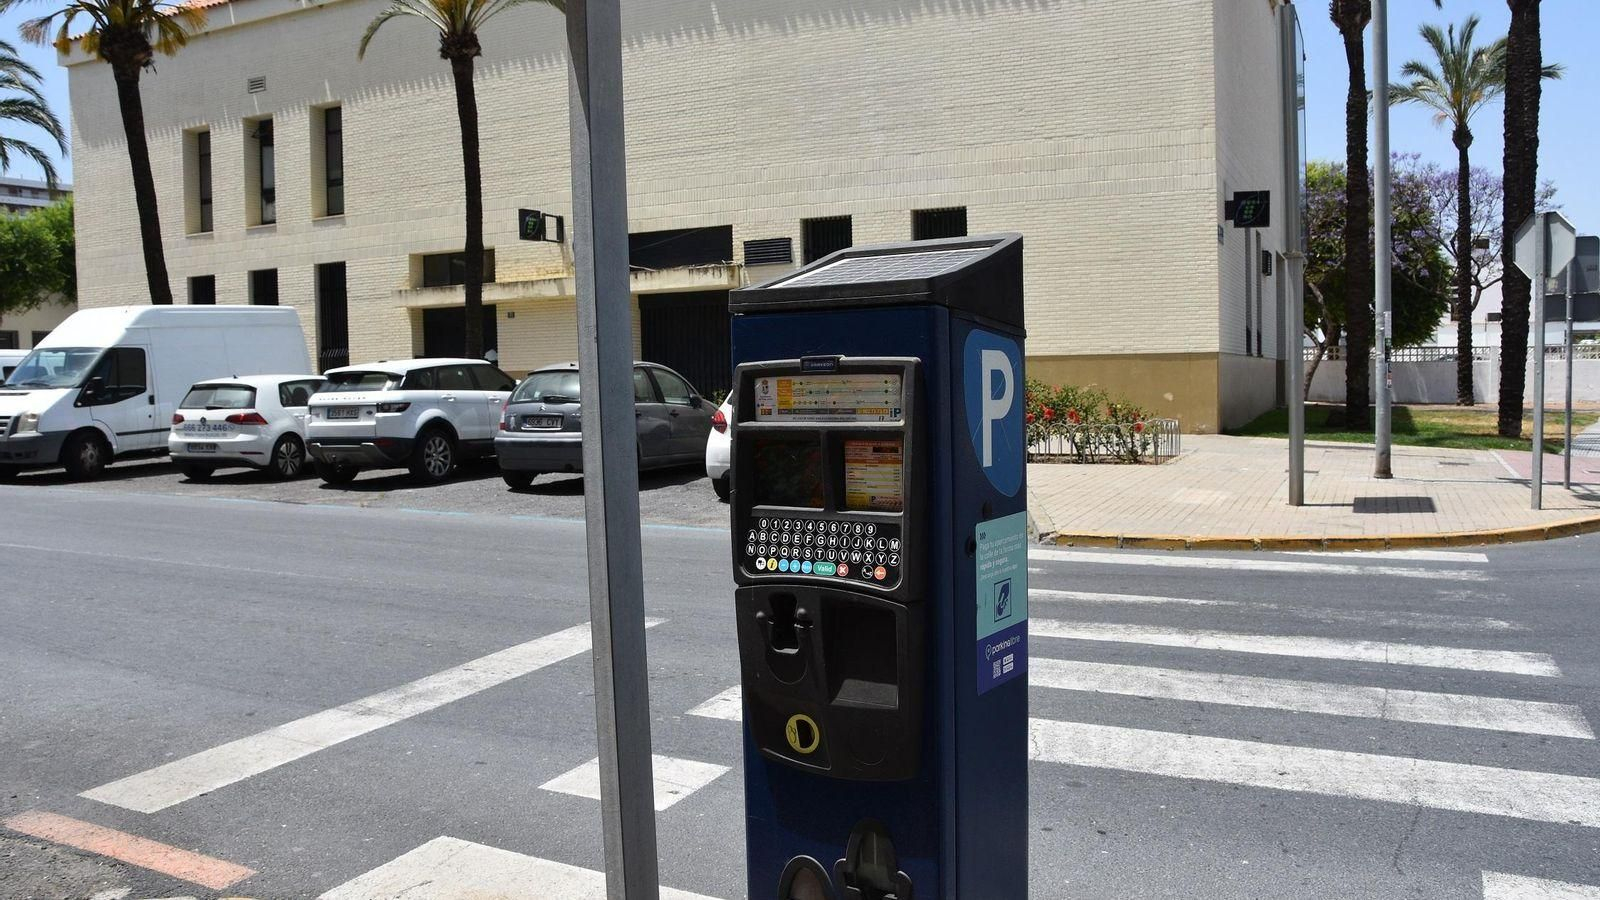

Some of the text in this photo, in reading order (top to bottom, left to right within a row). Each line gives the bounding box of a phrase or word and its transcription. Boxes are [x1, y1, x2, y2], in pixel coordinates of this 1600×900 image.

[982, 350, 1014, 467] P
[761, 519, 873, 534] 0 1 2 3 4 5 6 7 8 9
[749, 531, 900, 550] A B C D E F G H I J K L M
[748, 545, 897, 564] N O P Q R S T U V W X Y Z
[817, 565, 833, 573] Valid
